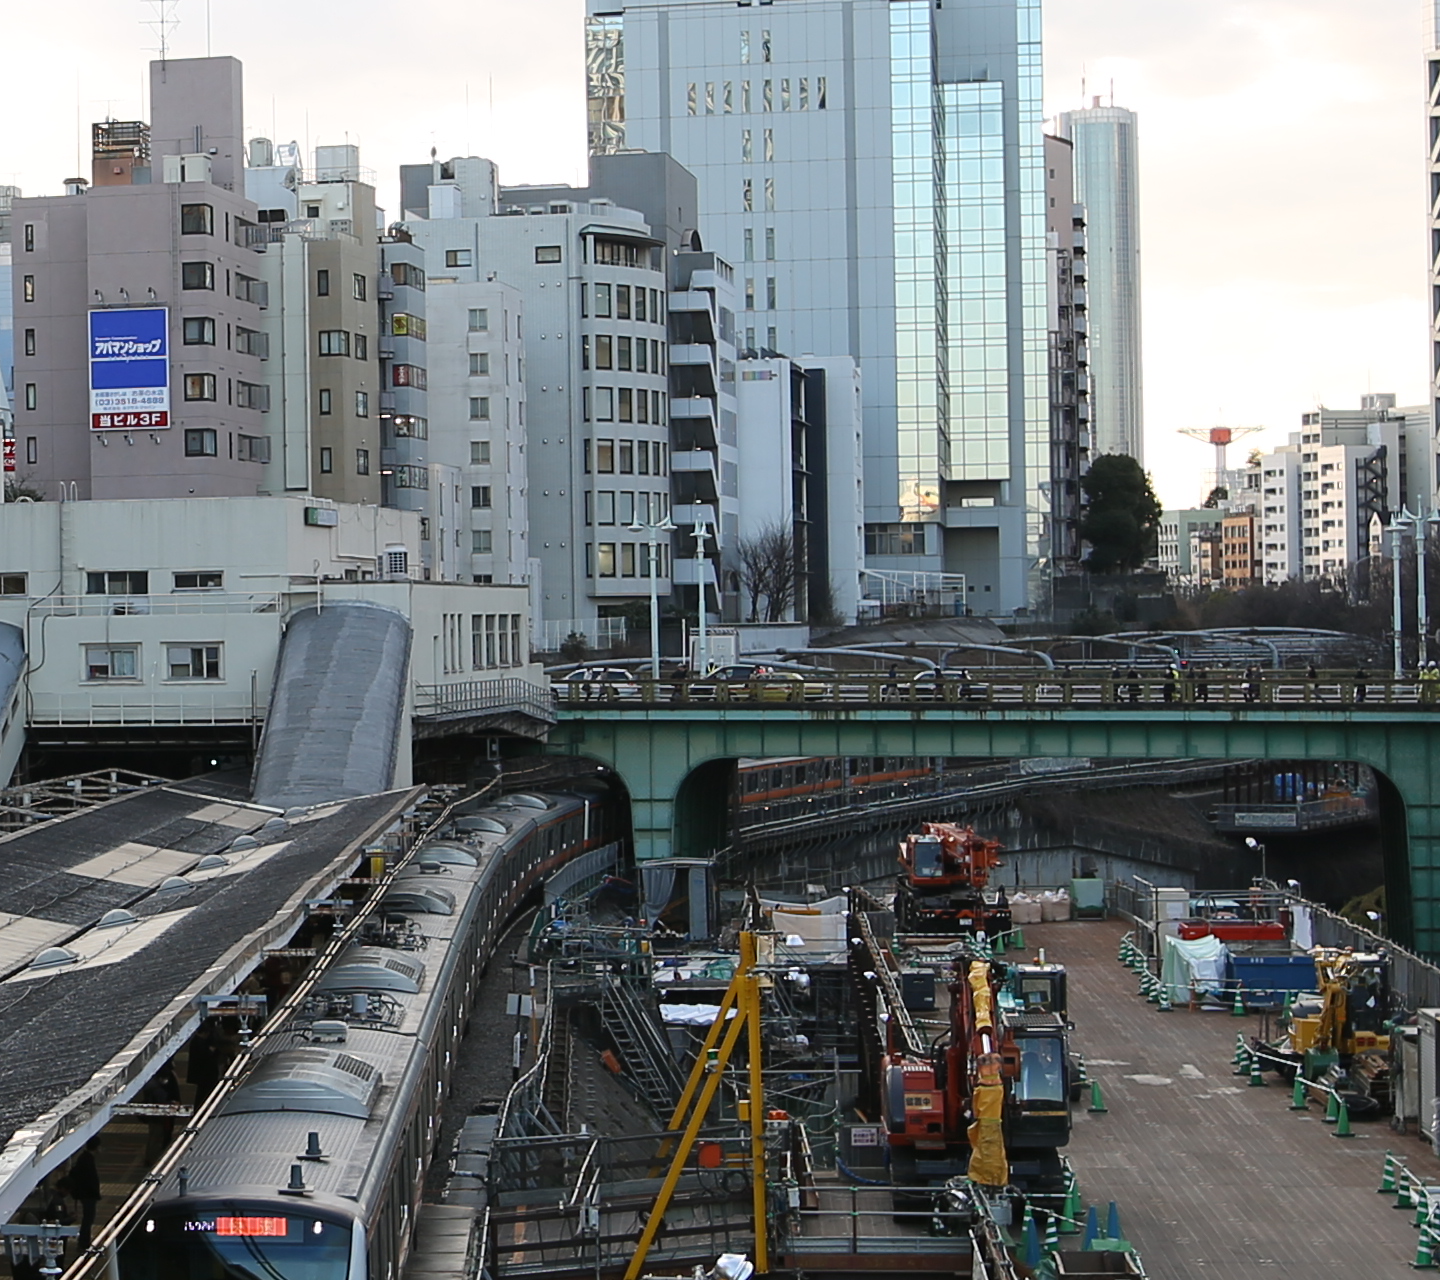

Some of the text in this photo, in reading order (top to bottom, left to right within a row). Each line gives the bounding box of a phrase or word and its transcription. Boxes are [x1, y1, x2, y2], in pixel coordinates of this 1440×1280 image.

[95, 339, 162, 355] アパマンショップ
[99, 413, 161, 427] 当ビル3F
